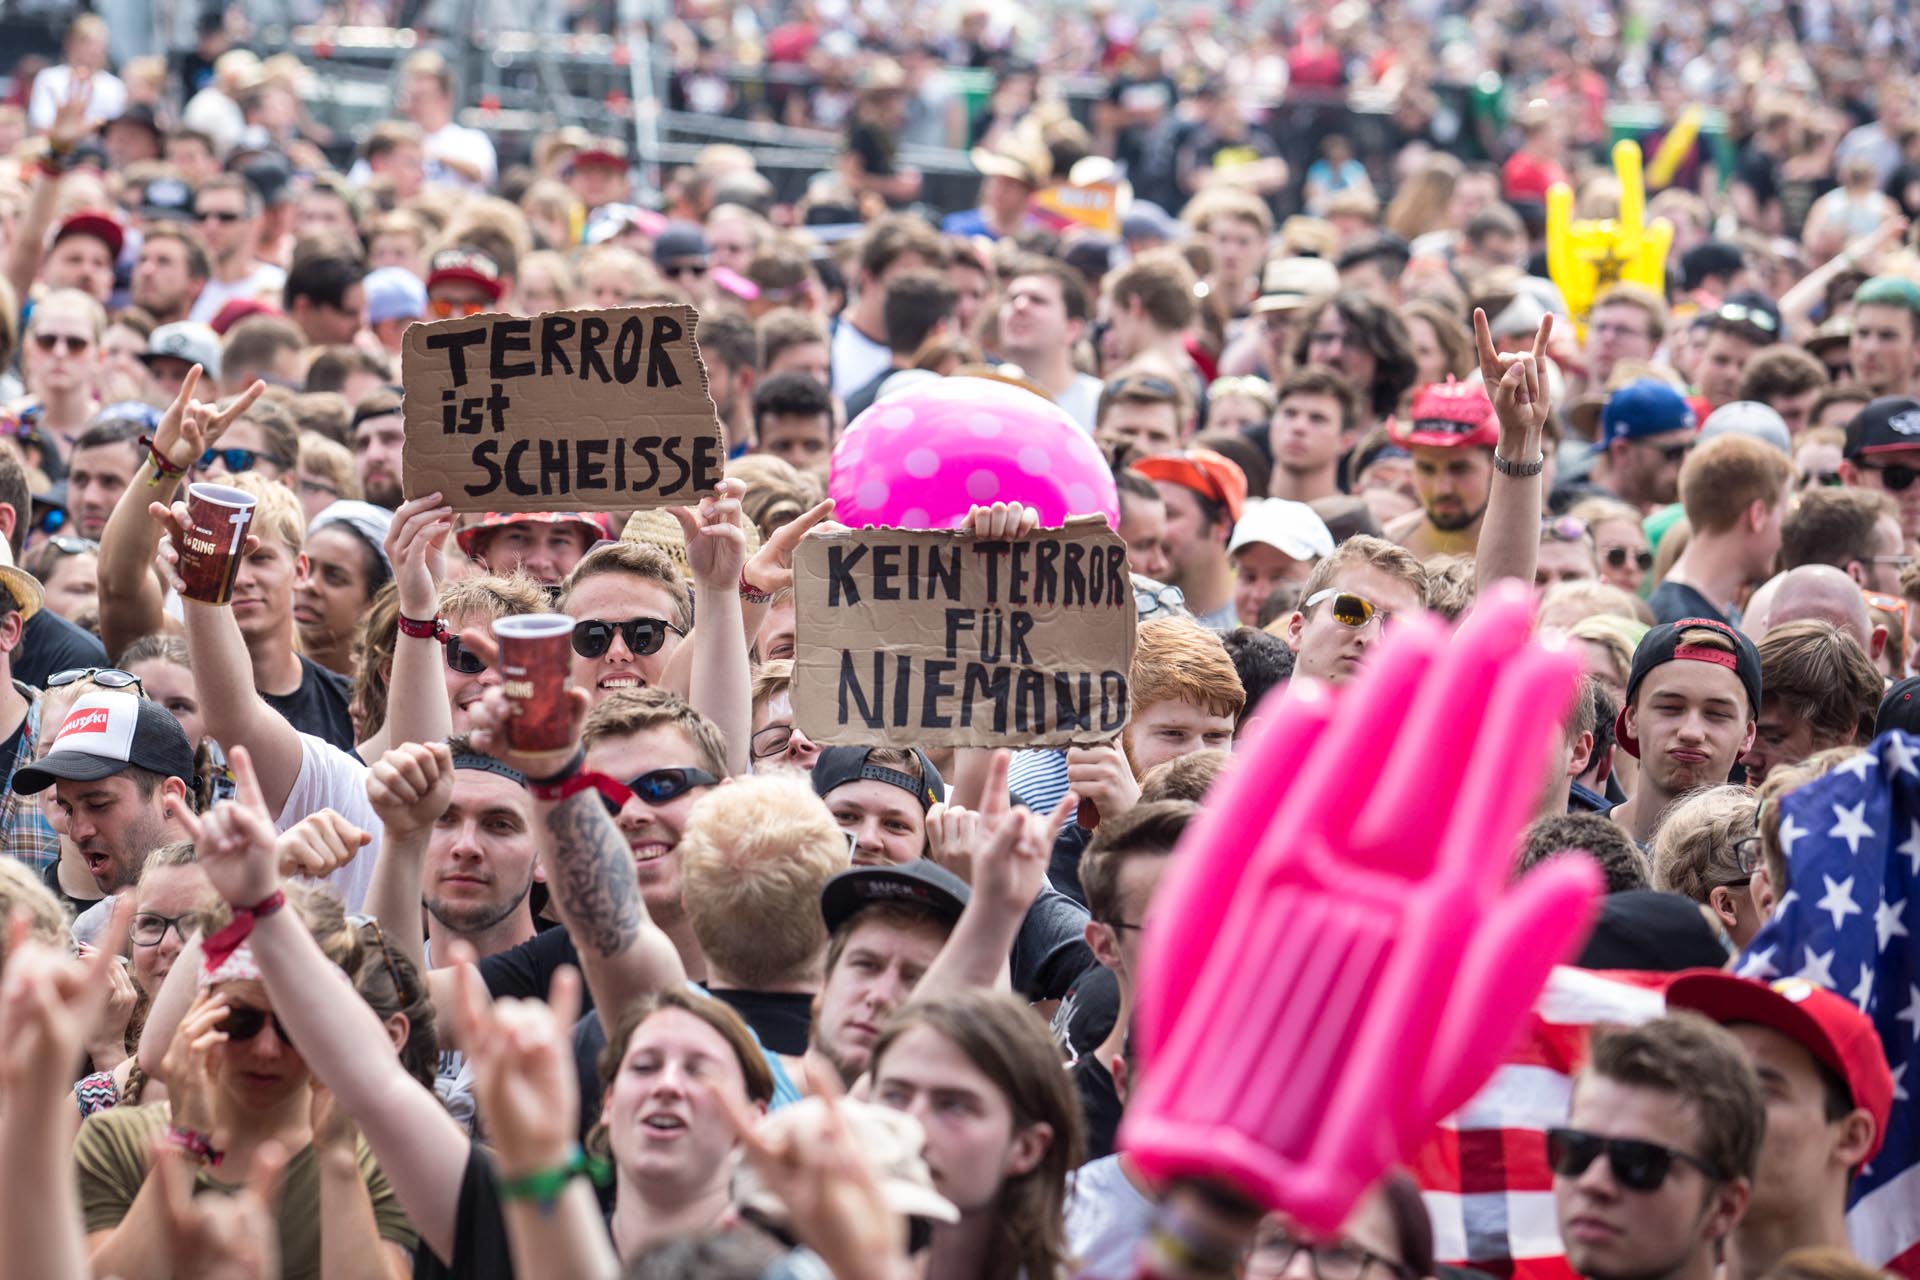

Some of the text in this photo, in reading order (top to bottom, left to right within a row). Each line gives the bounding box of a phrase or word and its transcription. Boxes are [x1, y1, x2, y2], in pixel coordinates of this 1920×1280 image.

[426, 316, 683, 389] TERROR
[442, 384, 511, 434] ist
[464, 436, 722, 497] SCHEISSE
[191, 537, 217, 556] RING
[828, 539, 1126, 608] KEIN TERROR
[945, 607, 1034, 665] FÜR
[838, 649, 1127, 735] NIEMAND
